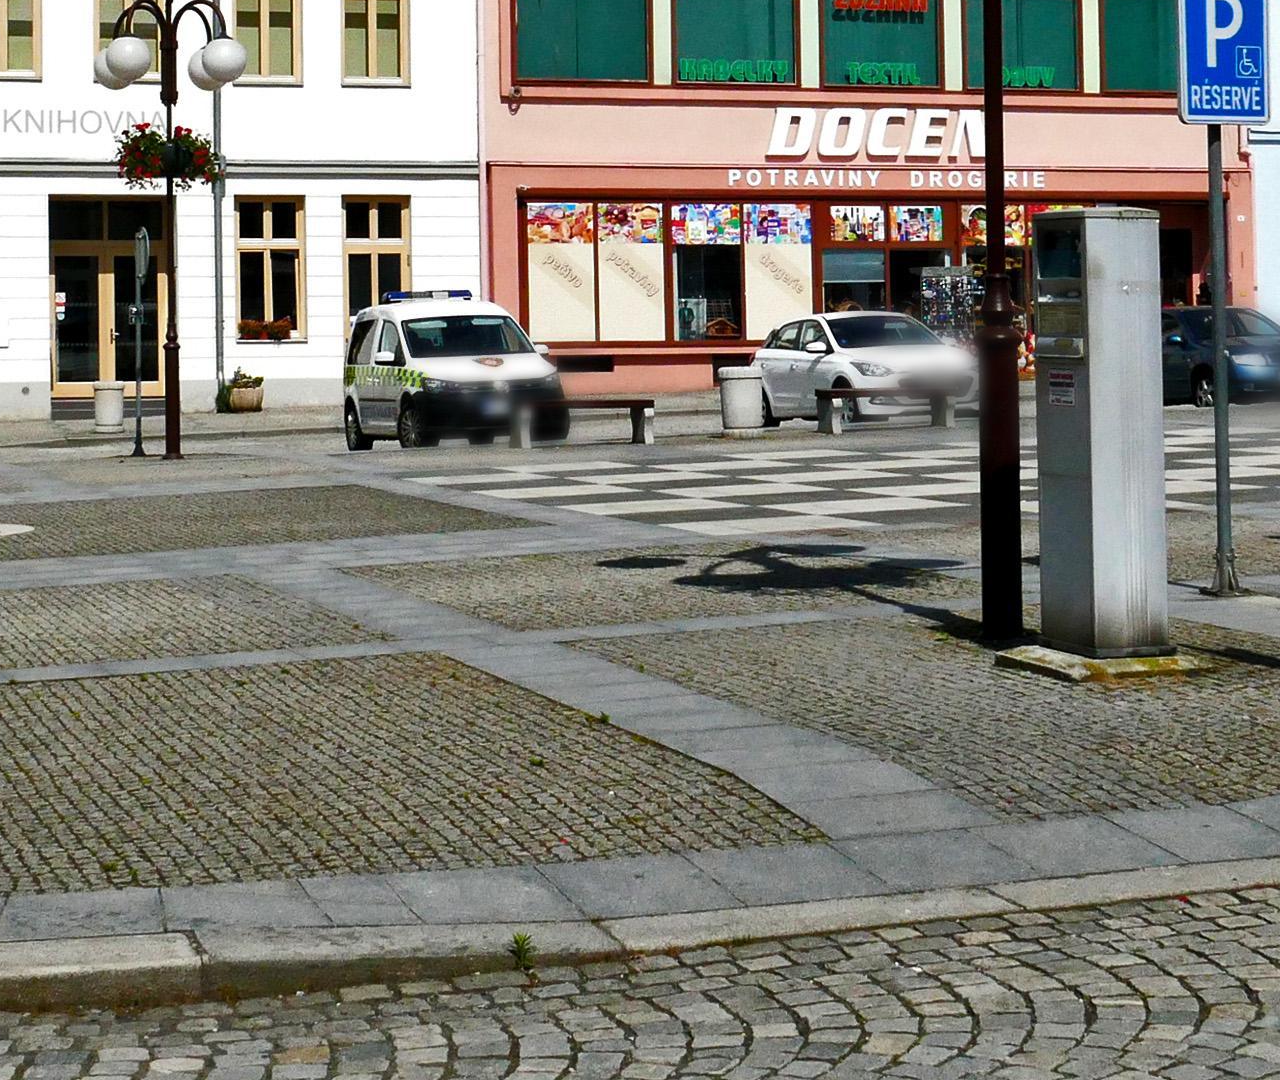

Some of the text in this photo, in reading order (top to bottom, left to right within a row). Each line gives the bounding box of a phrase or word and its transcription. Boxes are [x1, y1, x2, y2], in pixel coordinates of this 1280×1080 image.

[680, 58, 789, 82] KABELKY
[847, 62, 921, 85] TEXTIL
[727, 169, 1046, 189] POTRAVINY DROGRIE
[605, 250, 660, 298] potraviny
[759, 252, 805, 295] drogerie
